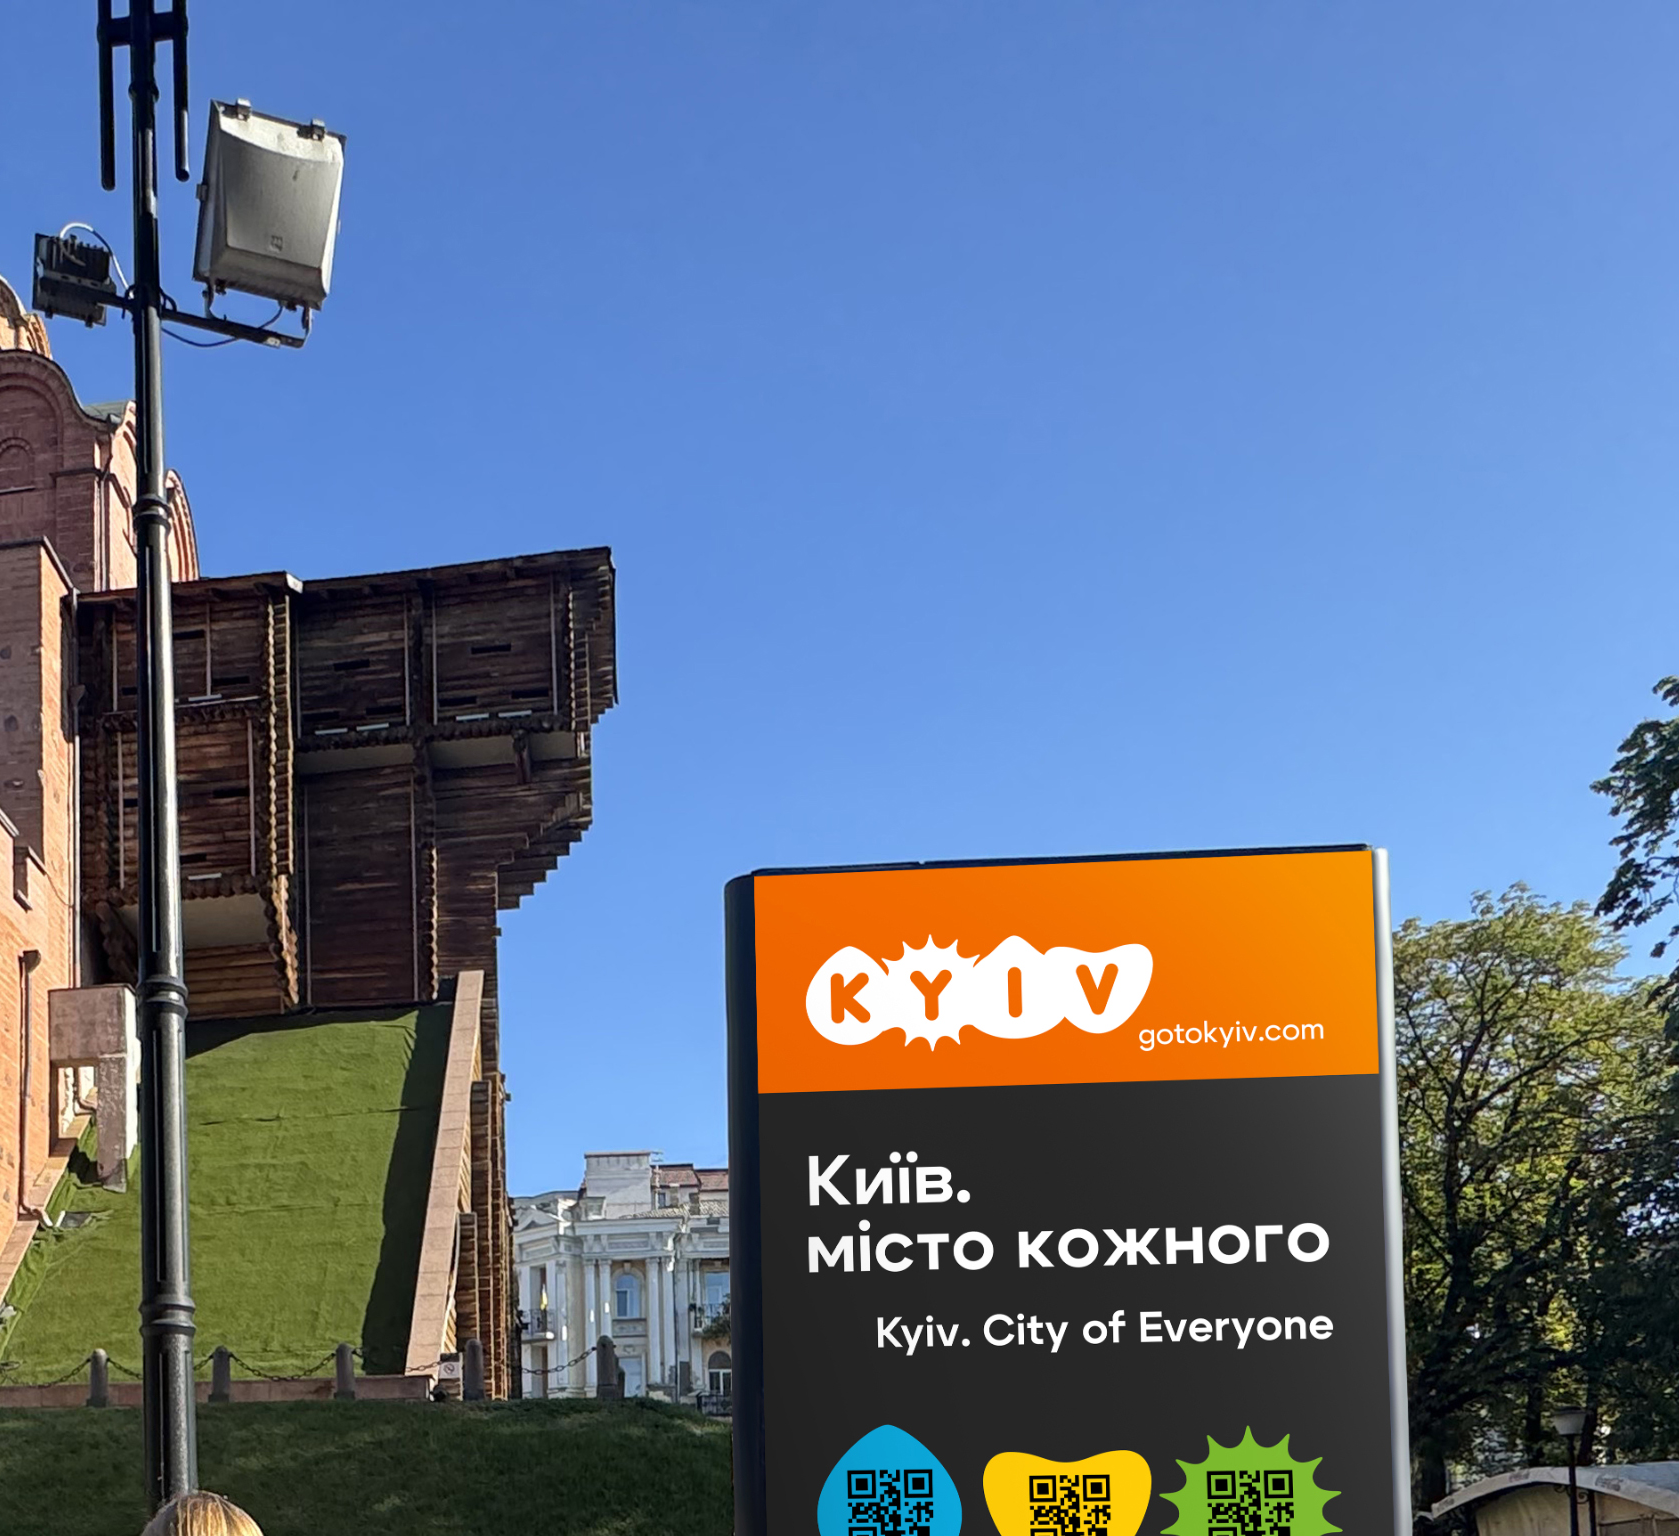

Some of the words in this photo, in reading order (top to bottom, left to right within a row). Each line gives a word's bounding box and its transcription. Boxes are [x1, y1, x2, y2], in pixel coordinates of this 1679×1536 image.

[826, 961, 1121, 1026] KYIV
[1138, 1020, 1324, 1051] gotokyiv.com
[808, 1150, 970, 1206] Київ.
[808, 1219, 994, 1273] місто
[1018, 1222, 1329, 1268] кожного
[877, 1314, 970, 1356] Kyiv.
[983, 1313, 1068, 1353] City
[1082, 1309, 1126, 1344] of
[1139, 1310, 1333, 1349] Everyone
